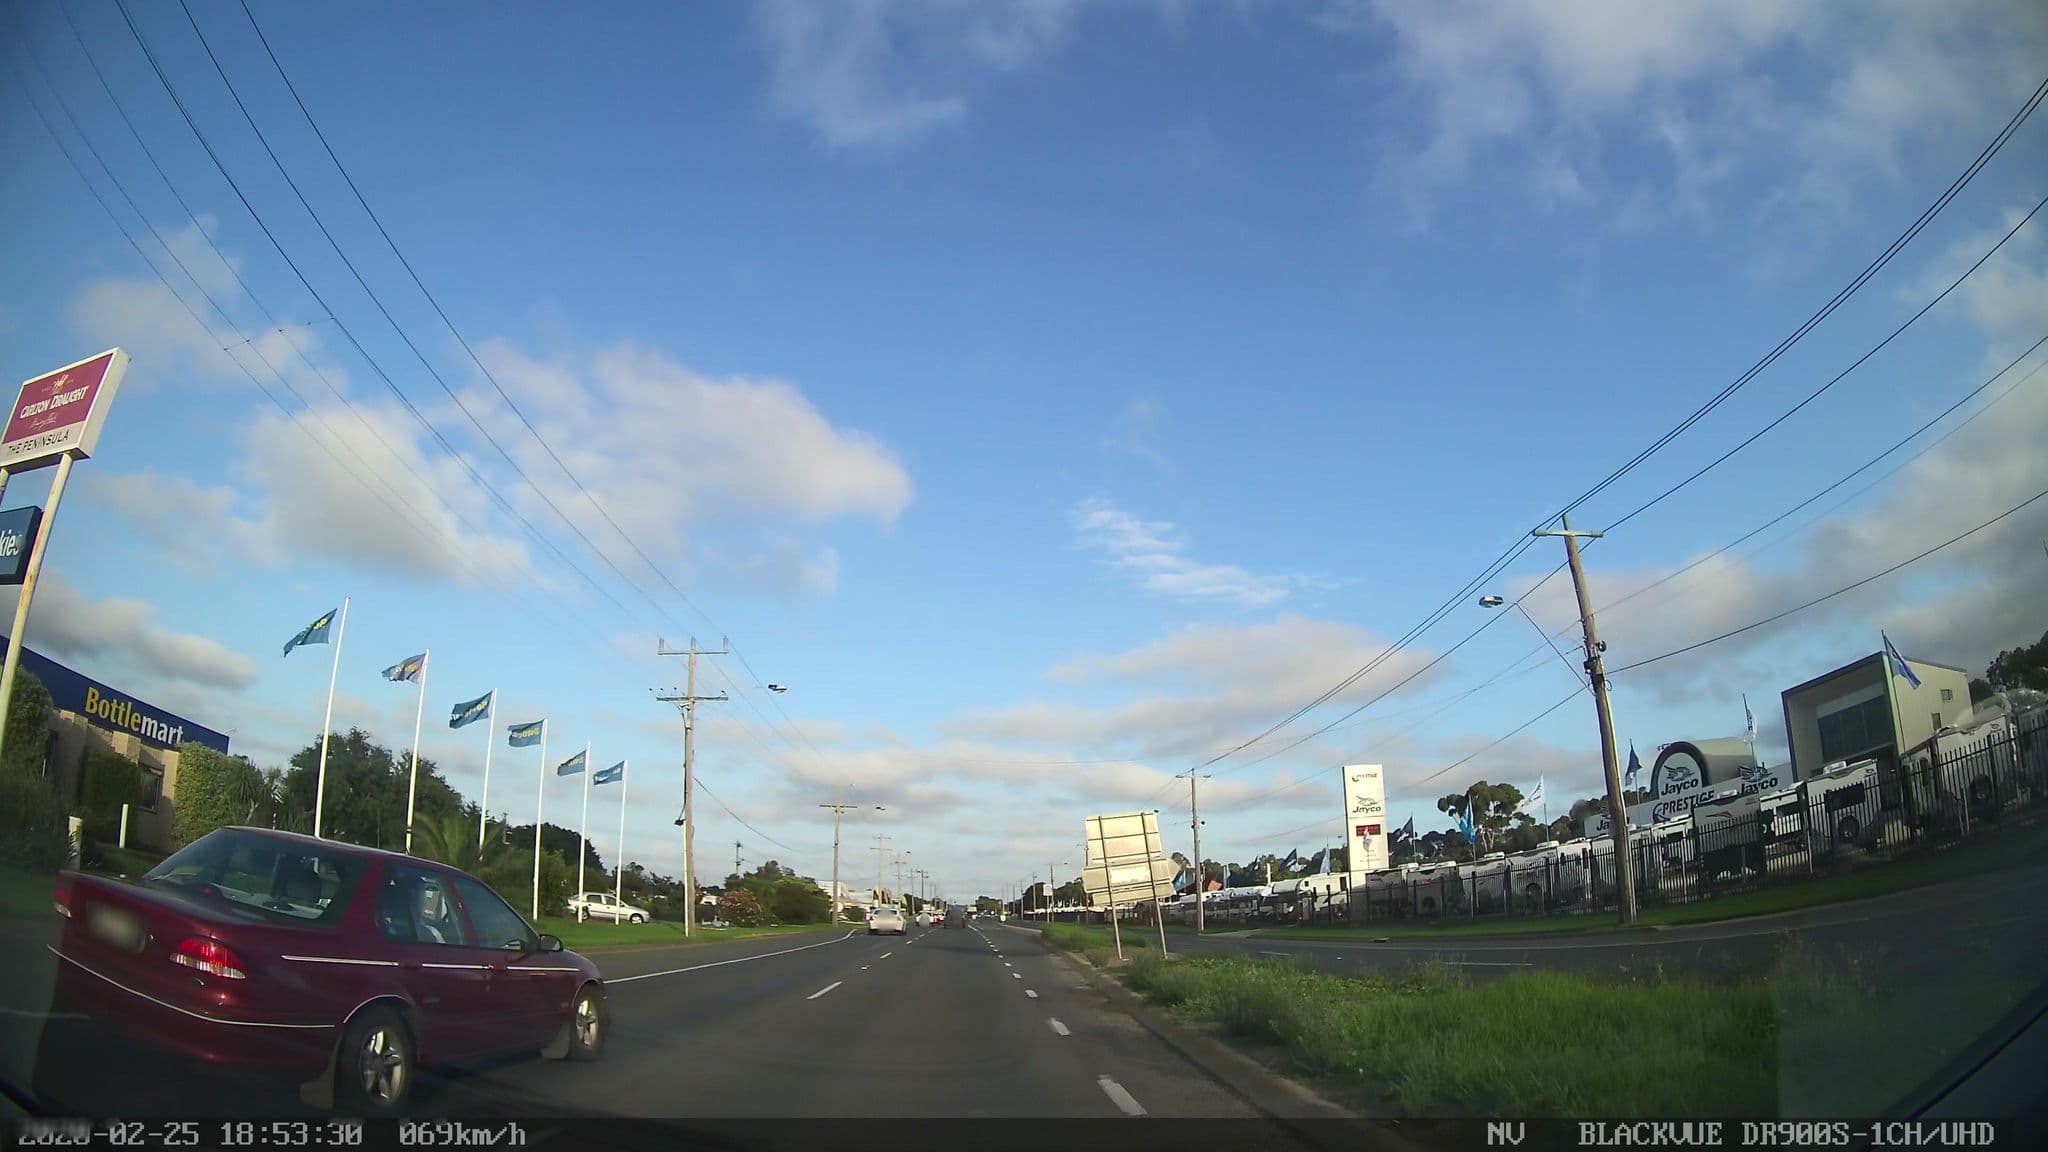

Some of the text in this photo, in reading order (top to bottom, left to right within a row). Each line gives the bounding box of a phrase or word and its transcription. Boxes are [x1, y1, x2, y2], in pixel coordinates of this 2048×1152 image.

[50, 386, 89, 410] DRAUGHT
[8, 429, 69, 455] THE PENINSULA
[85, 687, 184, 745] Bottlemart
[1661, 779, 1699, 796] Jayco
[1738, 777, 1778, 795] Jayco
[1352, 806, 1382, 815] Jayco
[1662, 790, 1715, 815] PRESTIGE
